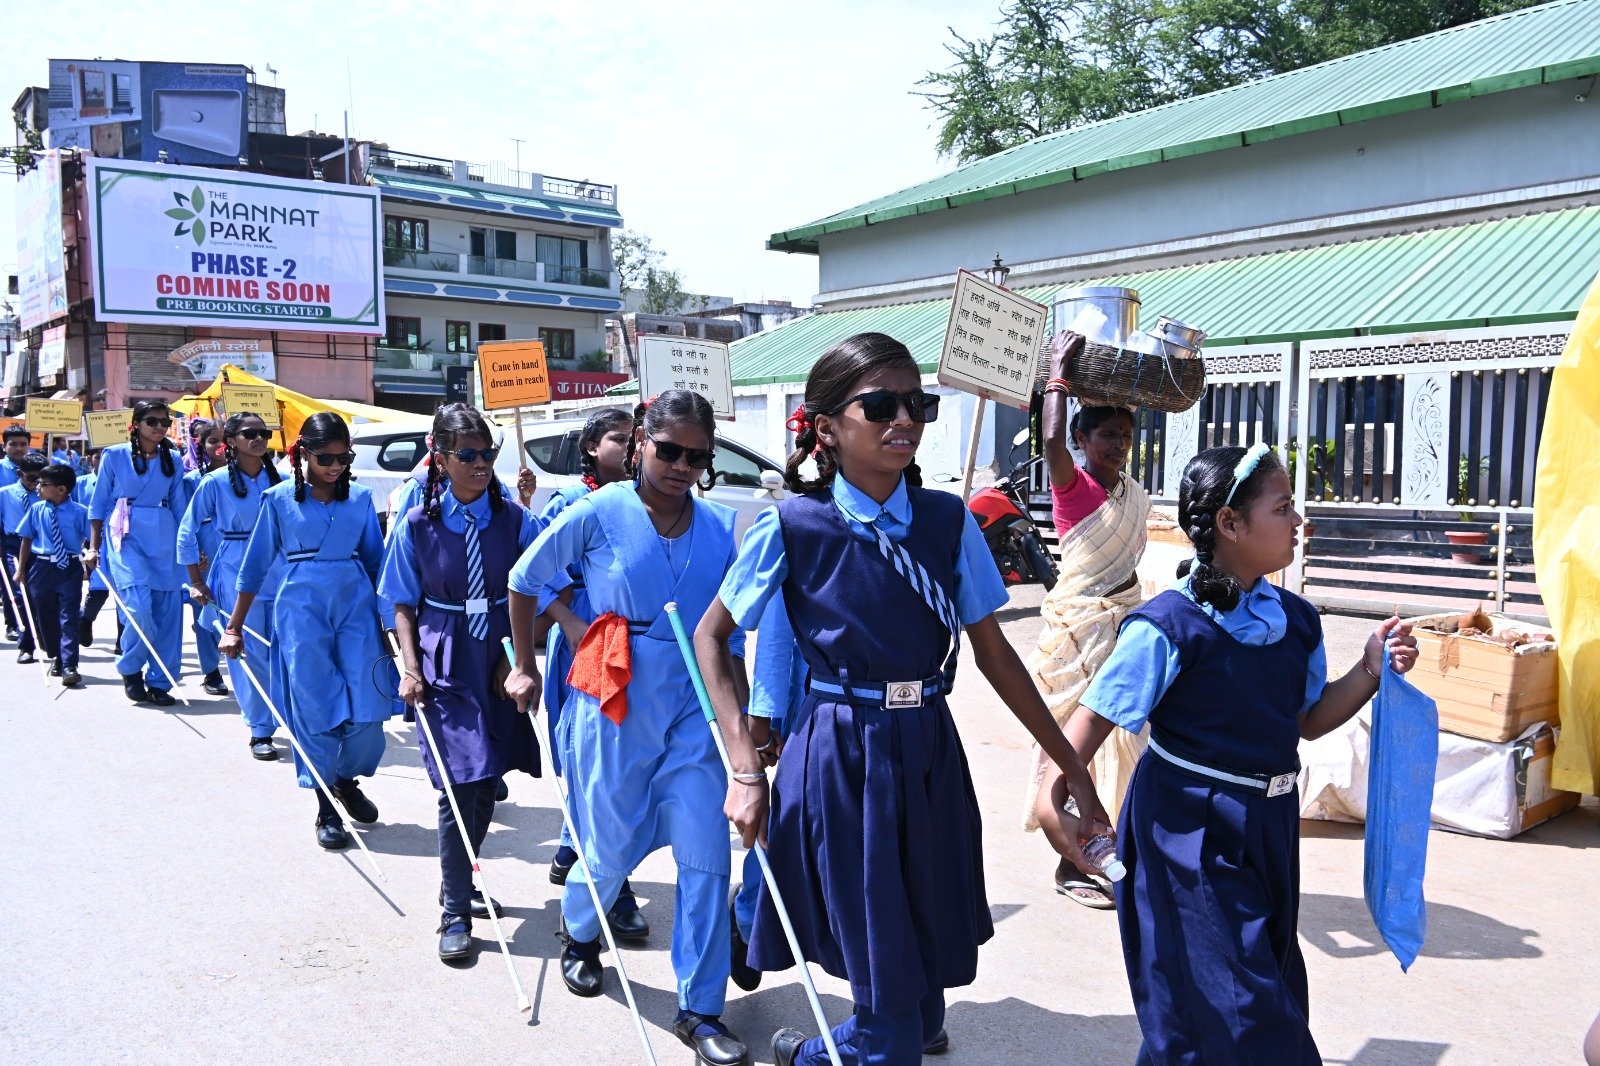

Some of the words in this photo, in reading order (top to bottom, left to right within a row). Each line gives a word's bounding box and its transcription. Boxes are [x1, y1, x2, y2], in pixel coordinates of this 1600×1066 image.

[208, 191, 228, 200] THE
[210, 200, 320, 227] MANNAT
[210, 222, 273, 243] PARK
[192, 252, 268, 278] PHASE
[274, 259, 297, 280] -2
[156, 274, 260, 300] COMING
[266, 281, 330, 304] SOON
[166, 300, 194, 310] PRE
[197, 300, 262, 314] BOOKING
[265, 305, 324, 316] STARTED
[972, 311, 991, 329] दिखाती
[492, 362, 511, 372] Cane
[512, 360, 520, 370] in
[522, 359, 539, 370] hand
[703, 366, 709, 376] से
[490, 378, 514, 388] dream
[516, 376, 522, 386] in
[525, 374, 544, 384] reach
[572, 382, 612, 395] TITAN
[700, 383, 709, 391] हम
